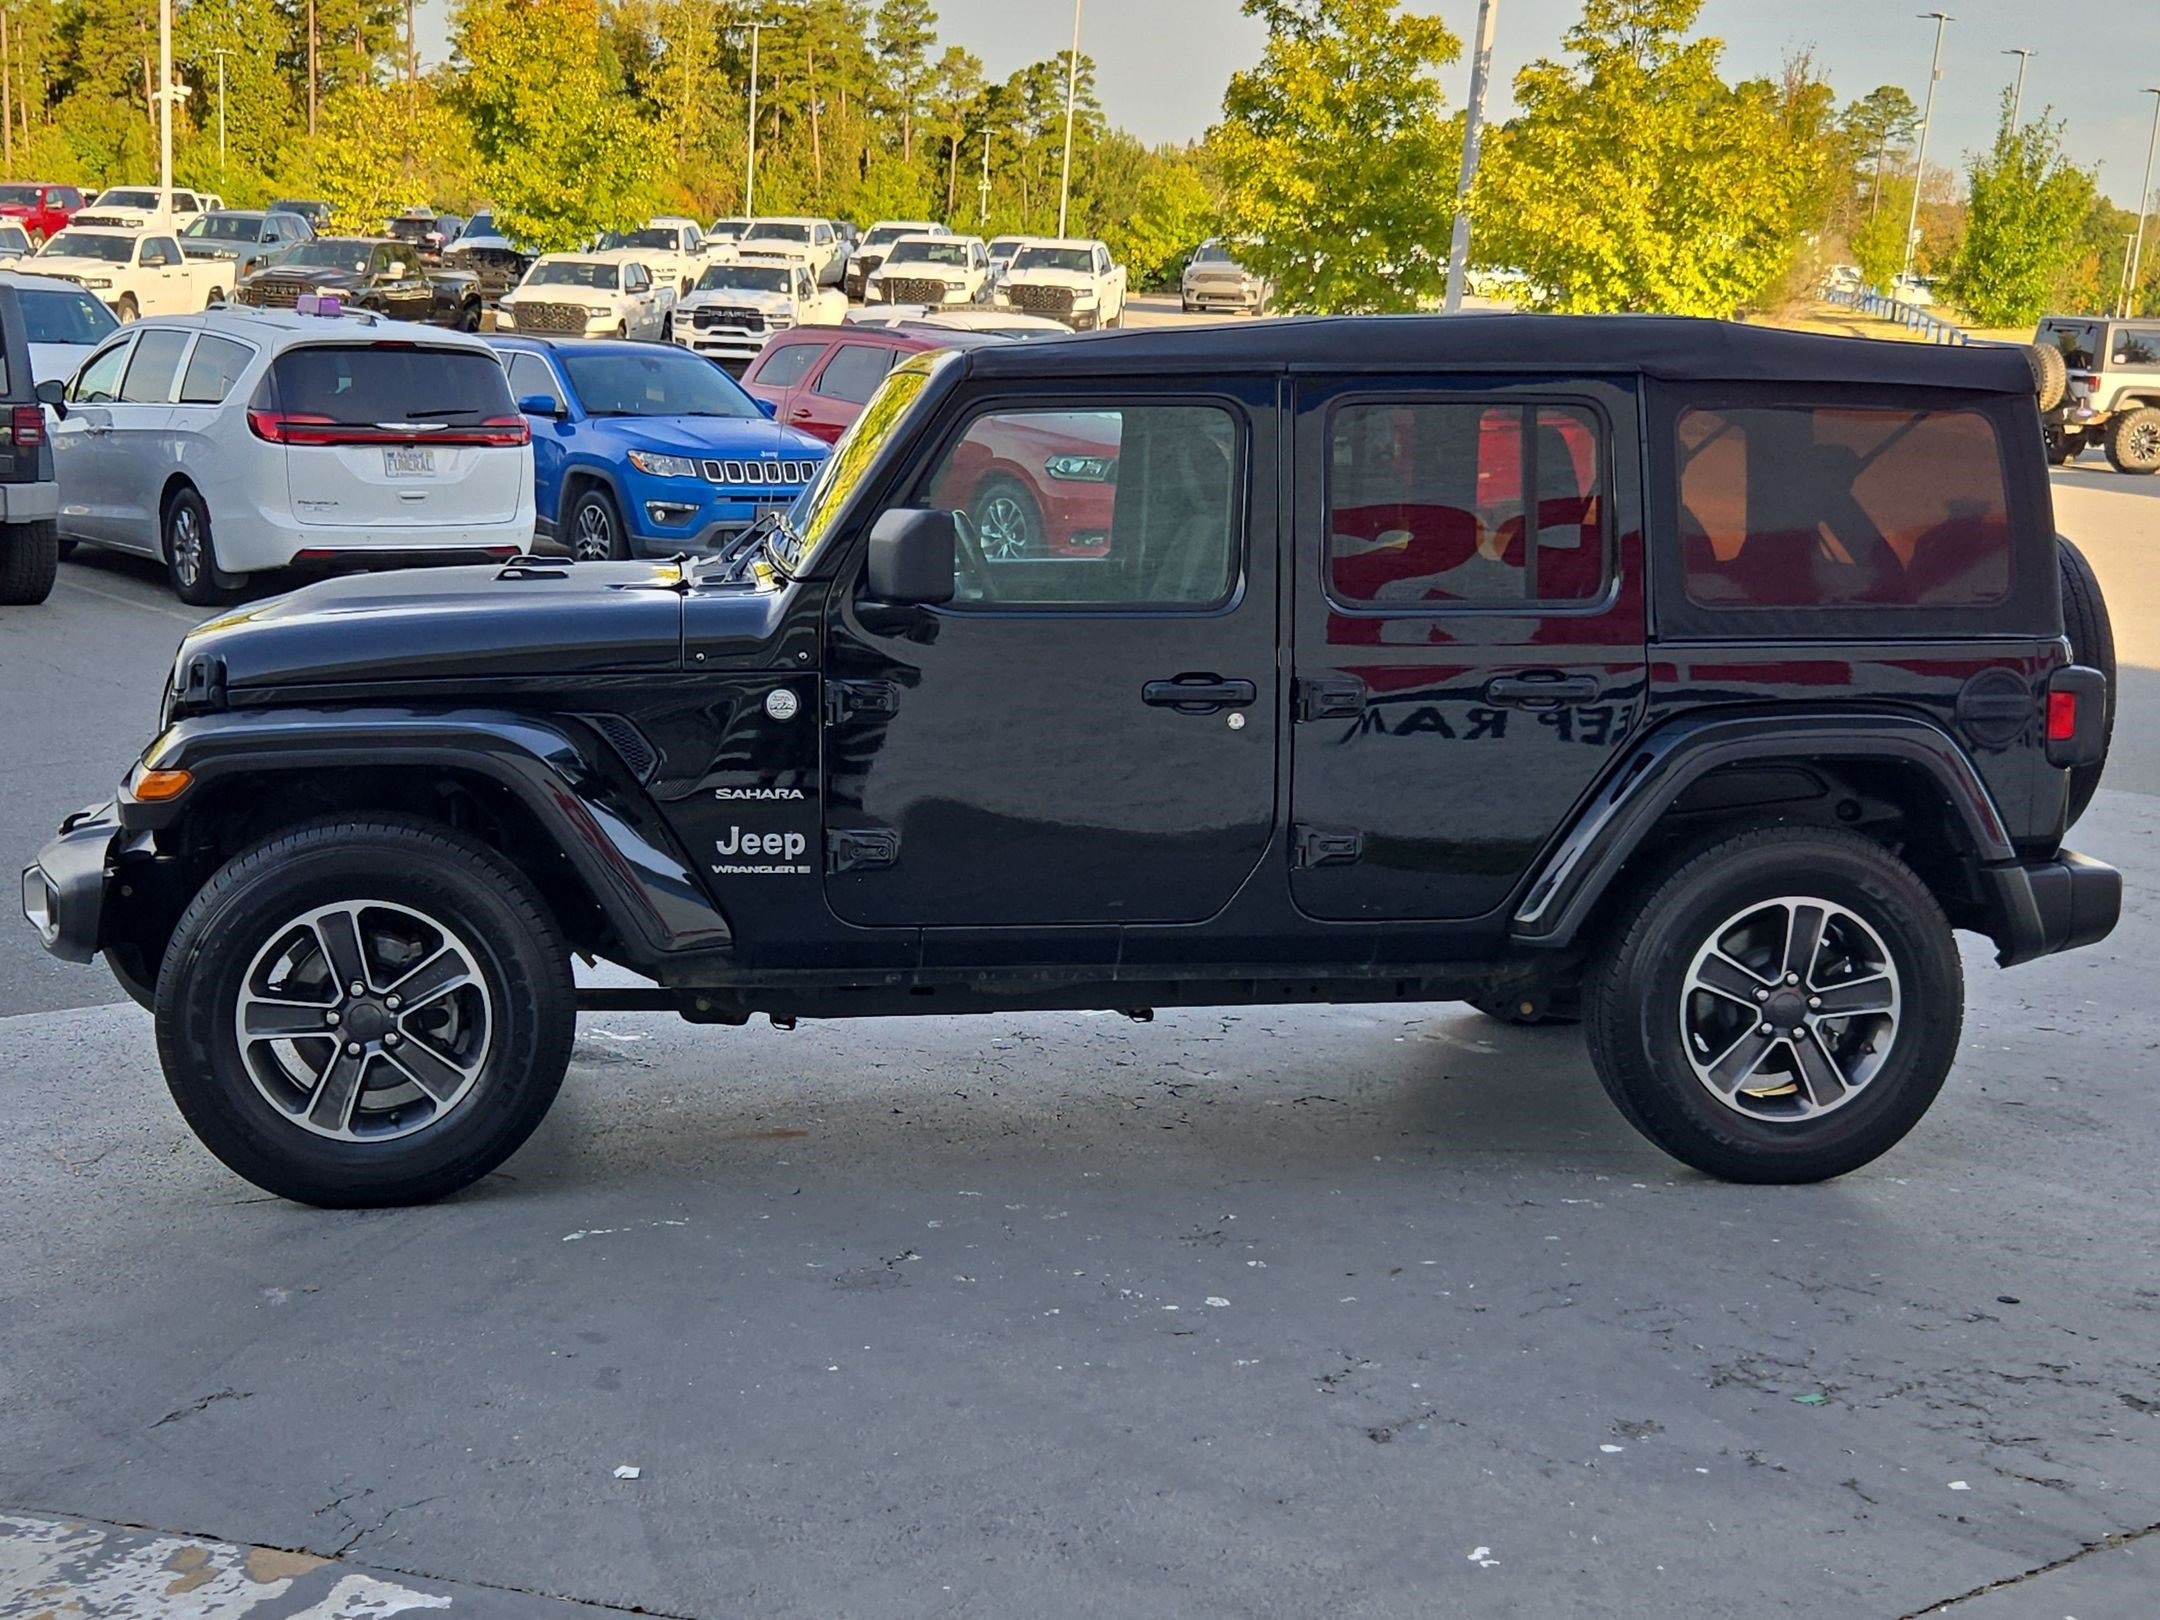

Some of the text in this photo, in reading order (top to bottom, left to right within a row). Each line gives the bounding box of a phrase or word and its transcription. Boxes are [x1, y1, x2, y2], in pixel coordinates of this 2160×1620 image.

[387, 459, 435, 472] FUNERAL
[715, 788, 804, 800] SAHARA
[715, 826, 806, 860] Jeep
[711, 864, 796, 874] WRANGLER
